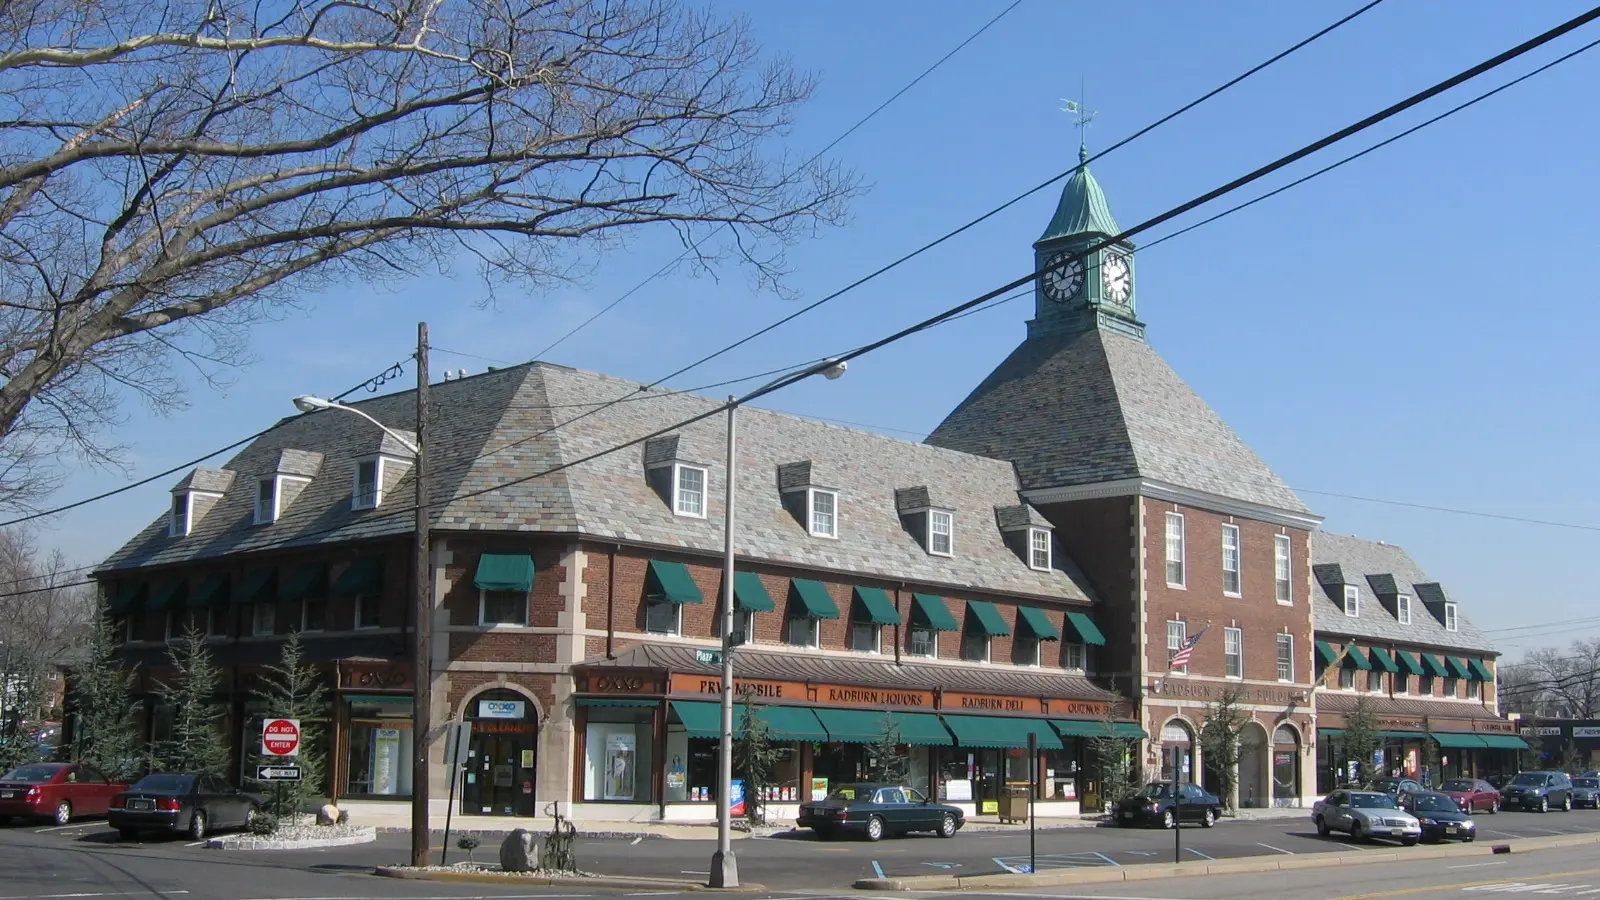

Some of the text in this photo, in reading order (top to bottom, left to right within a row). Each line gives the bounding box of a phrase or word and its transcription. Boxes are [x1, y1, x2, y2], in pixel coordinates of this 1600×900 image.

[696, 650, 713, 662] Plaza
[598, 675, 643, 692] OXXO
[735, 682, 783, 698] MOBILE
[1163, 683, 1210, 697] RADBURN
[829, 688, 923, 706] RADBURN LIQUORS
[962, 696, 1024, 711] RADBURN DELI
